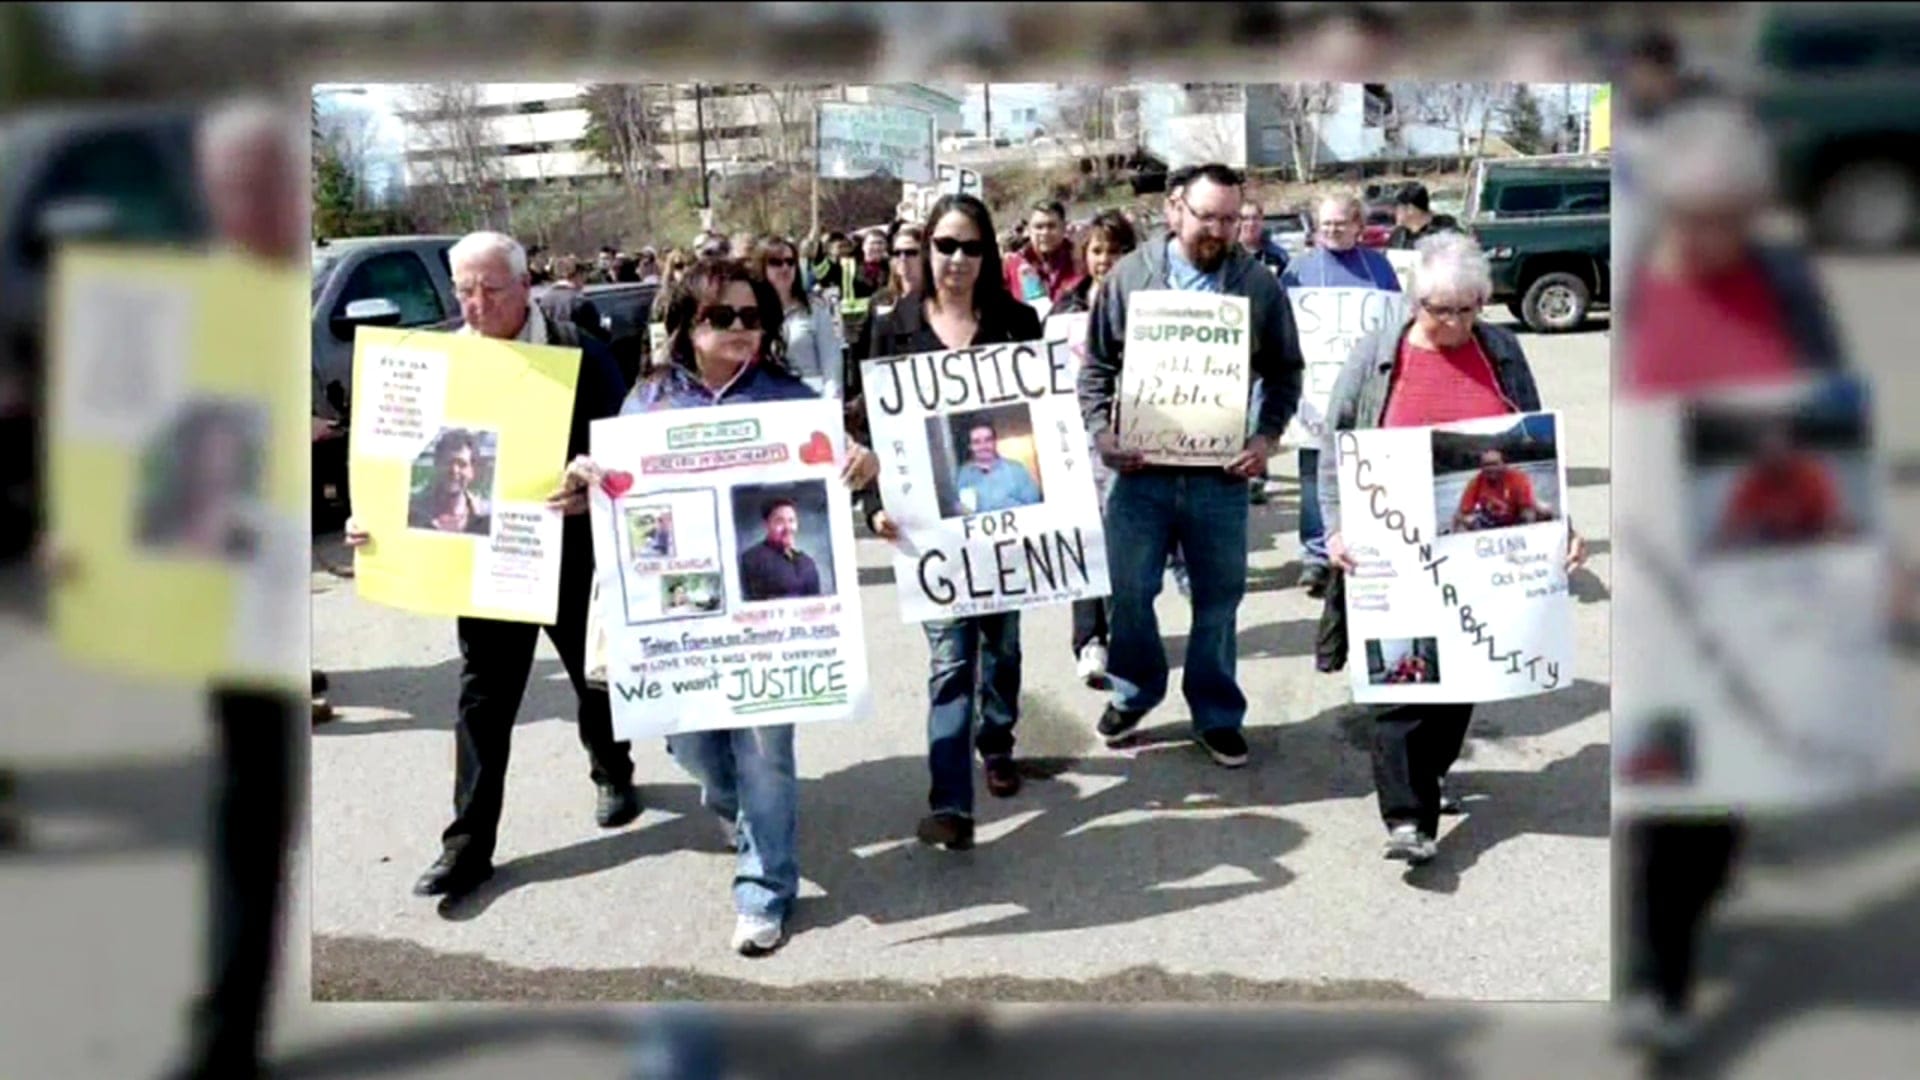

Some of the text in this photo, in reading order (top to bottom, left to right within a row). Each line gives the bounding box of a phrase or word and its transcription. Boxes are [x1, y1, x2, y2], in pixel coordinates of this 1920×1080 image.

[1298, 291, 1395, 334] SIGN
[1133, 324, 1243, 345] SUPPORT
[875, 338, 1074, 415] JUSTICE
[962, 510, 1018, 539] FOR
[919, 527, 1090, 605] GLENN
[616, 660, 848, 703] We want JUSTICE
[650, 657, 679, 671] LOVE
